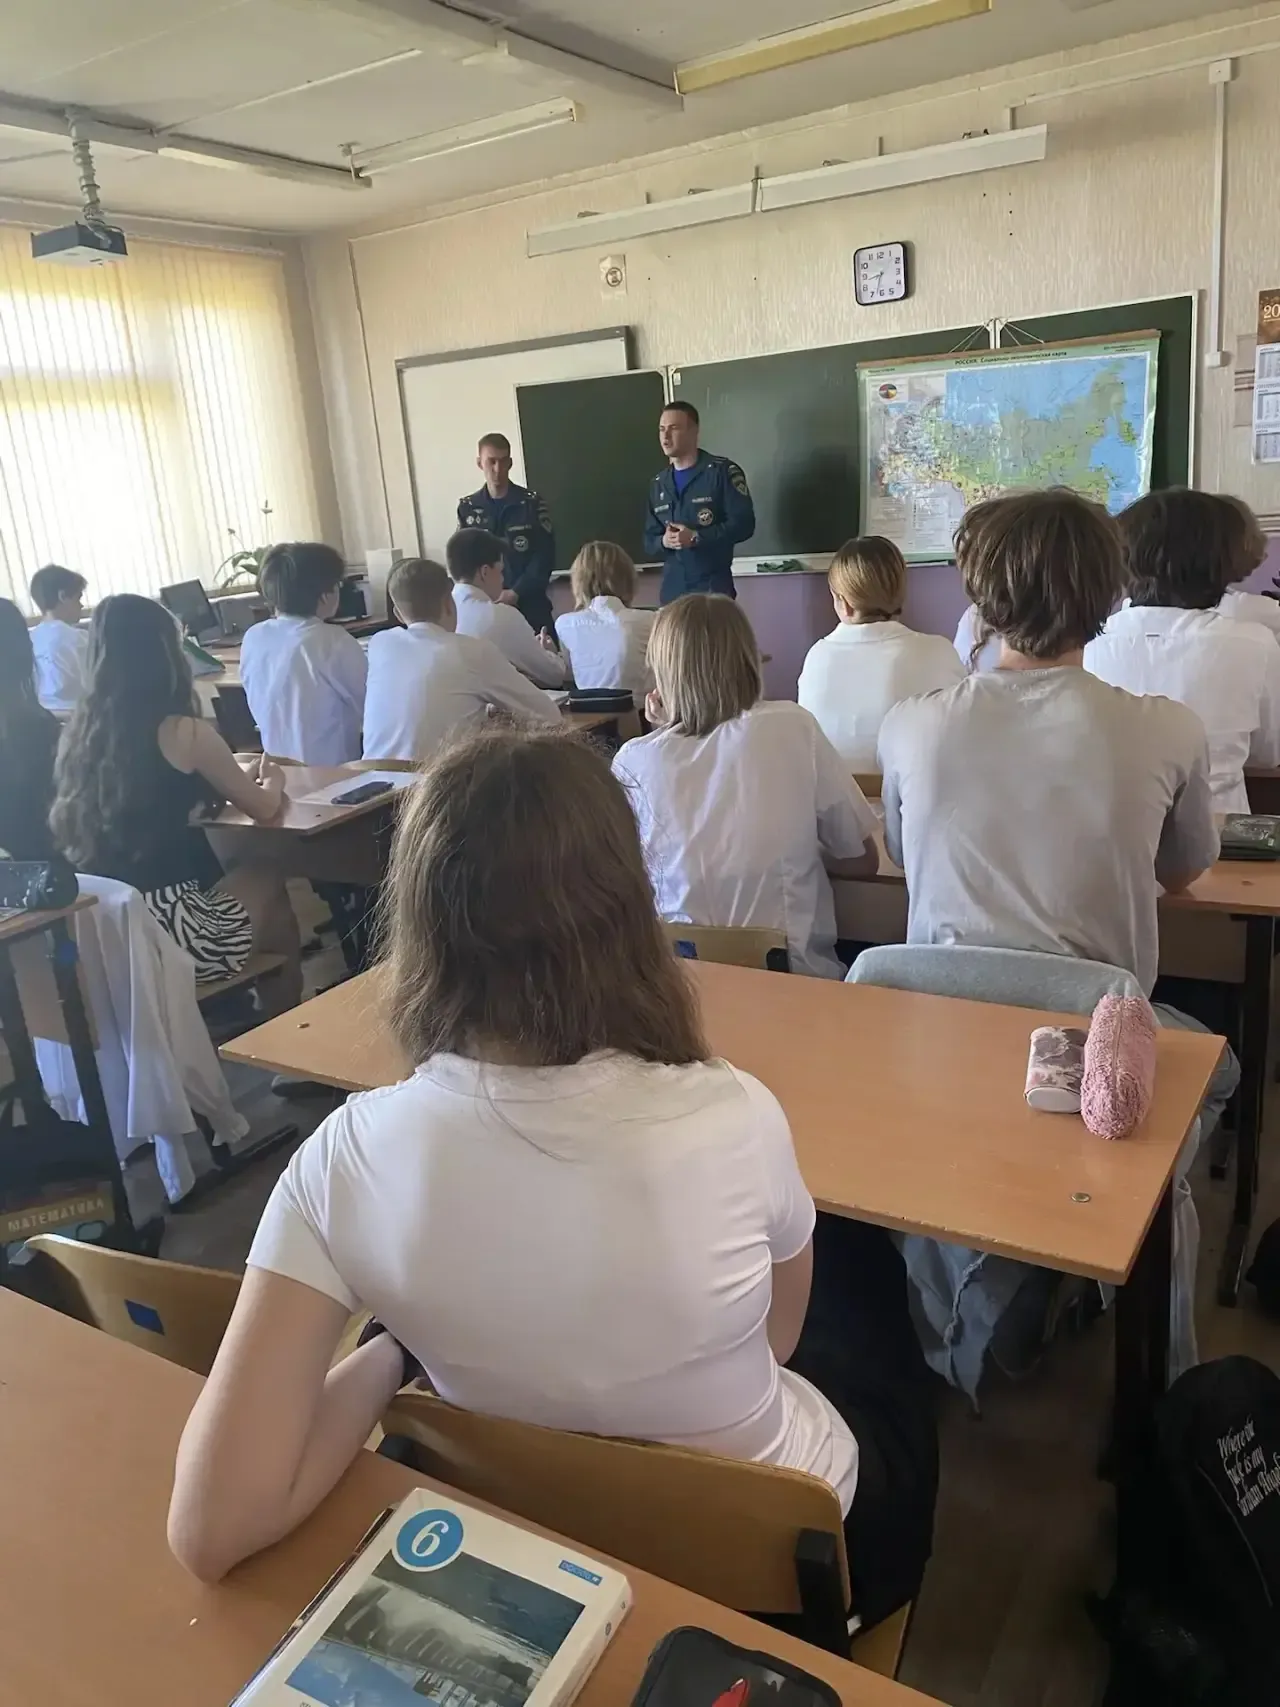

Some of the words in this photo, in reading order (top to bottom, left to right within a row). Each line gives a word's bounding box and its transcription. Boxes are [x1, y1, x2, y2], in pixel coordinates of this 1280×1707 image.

[877, 252, 884, 260] 12
[889, 288, 894, 296] 5
[7, 1198, 104, 1232] МАТЕМАТИКА
[411, 1520, 449, 1557] 6
